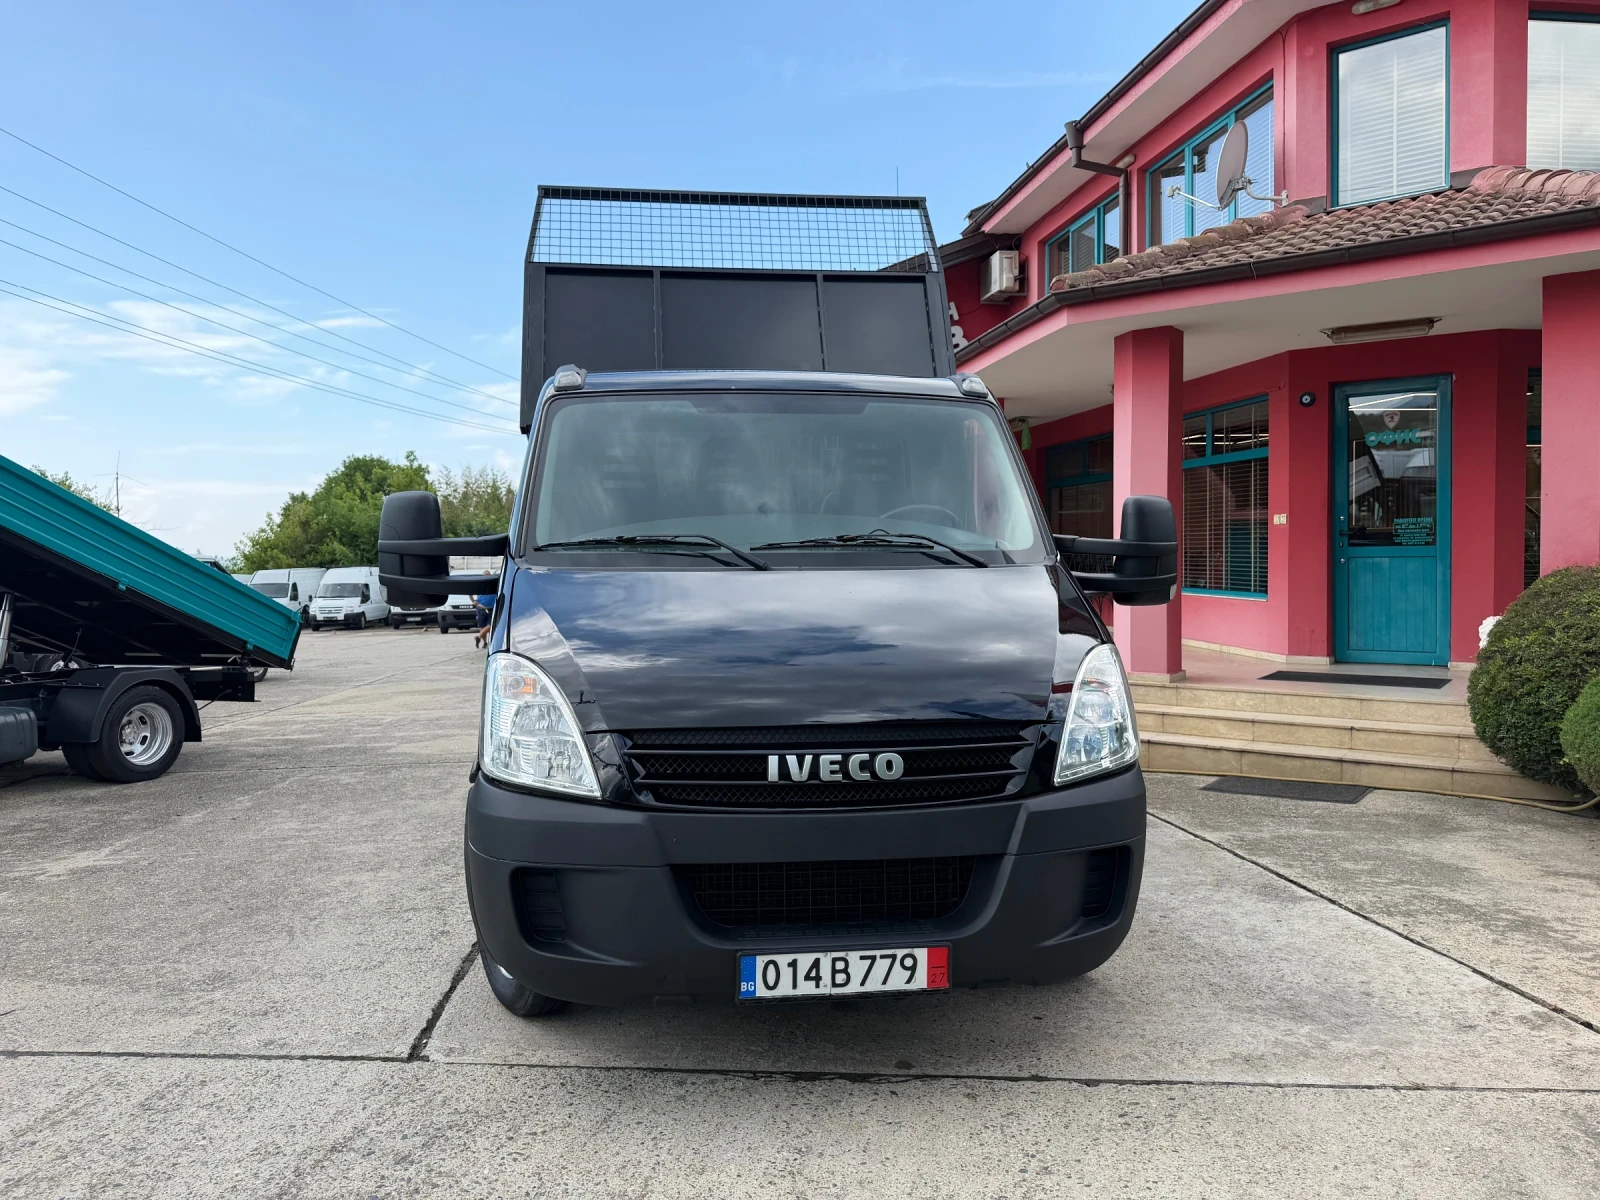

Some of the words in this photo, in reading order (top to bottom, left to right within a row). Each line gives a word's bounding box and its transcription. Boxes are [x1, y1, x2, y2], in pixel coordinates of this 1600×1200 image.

[1365, 428, 1421, 447] ОФИС
[767, 752, 904, 782] IVECO
[762, 953, 918, 991] 014B779
[930, 972, 946, 984] 27
[740, 981, 755, 991] BG
